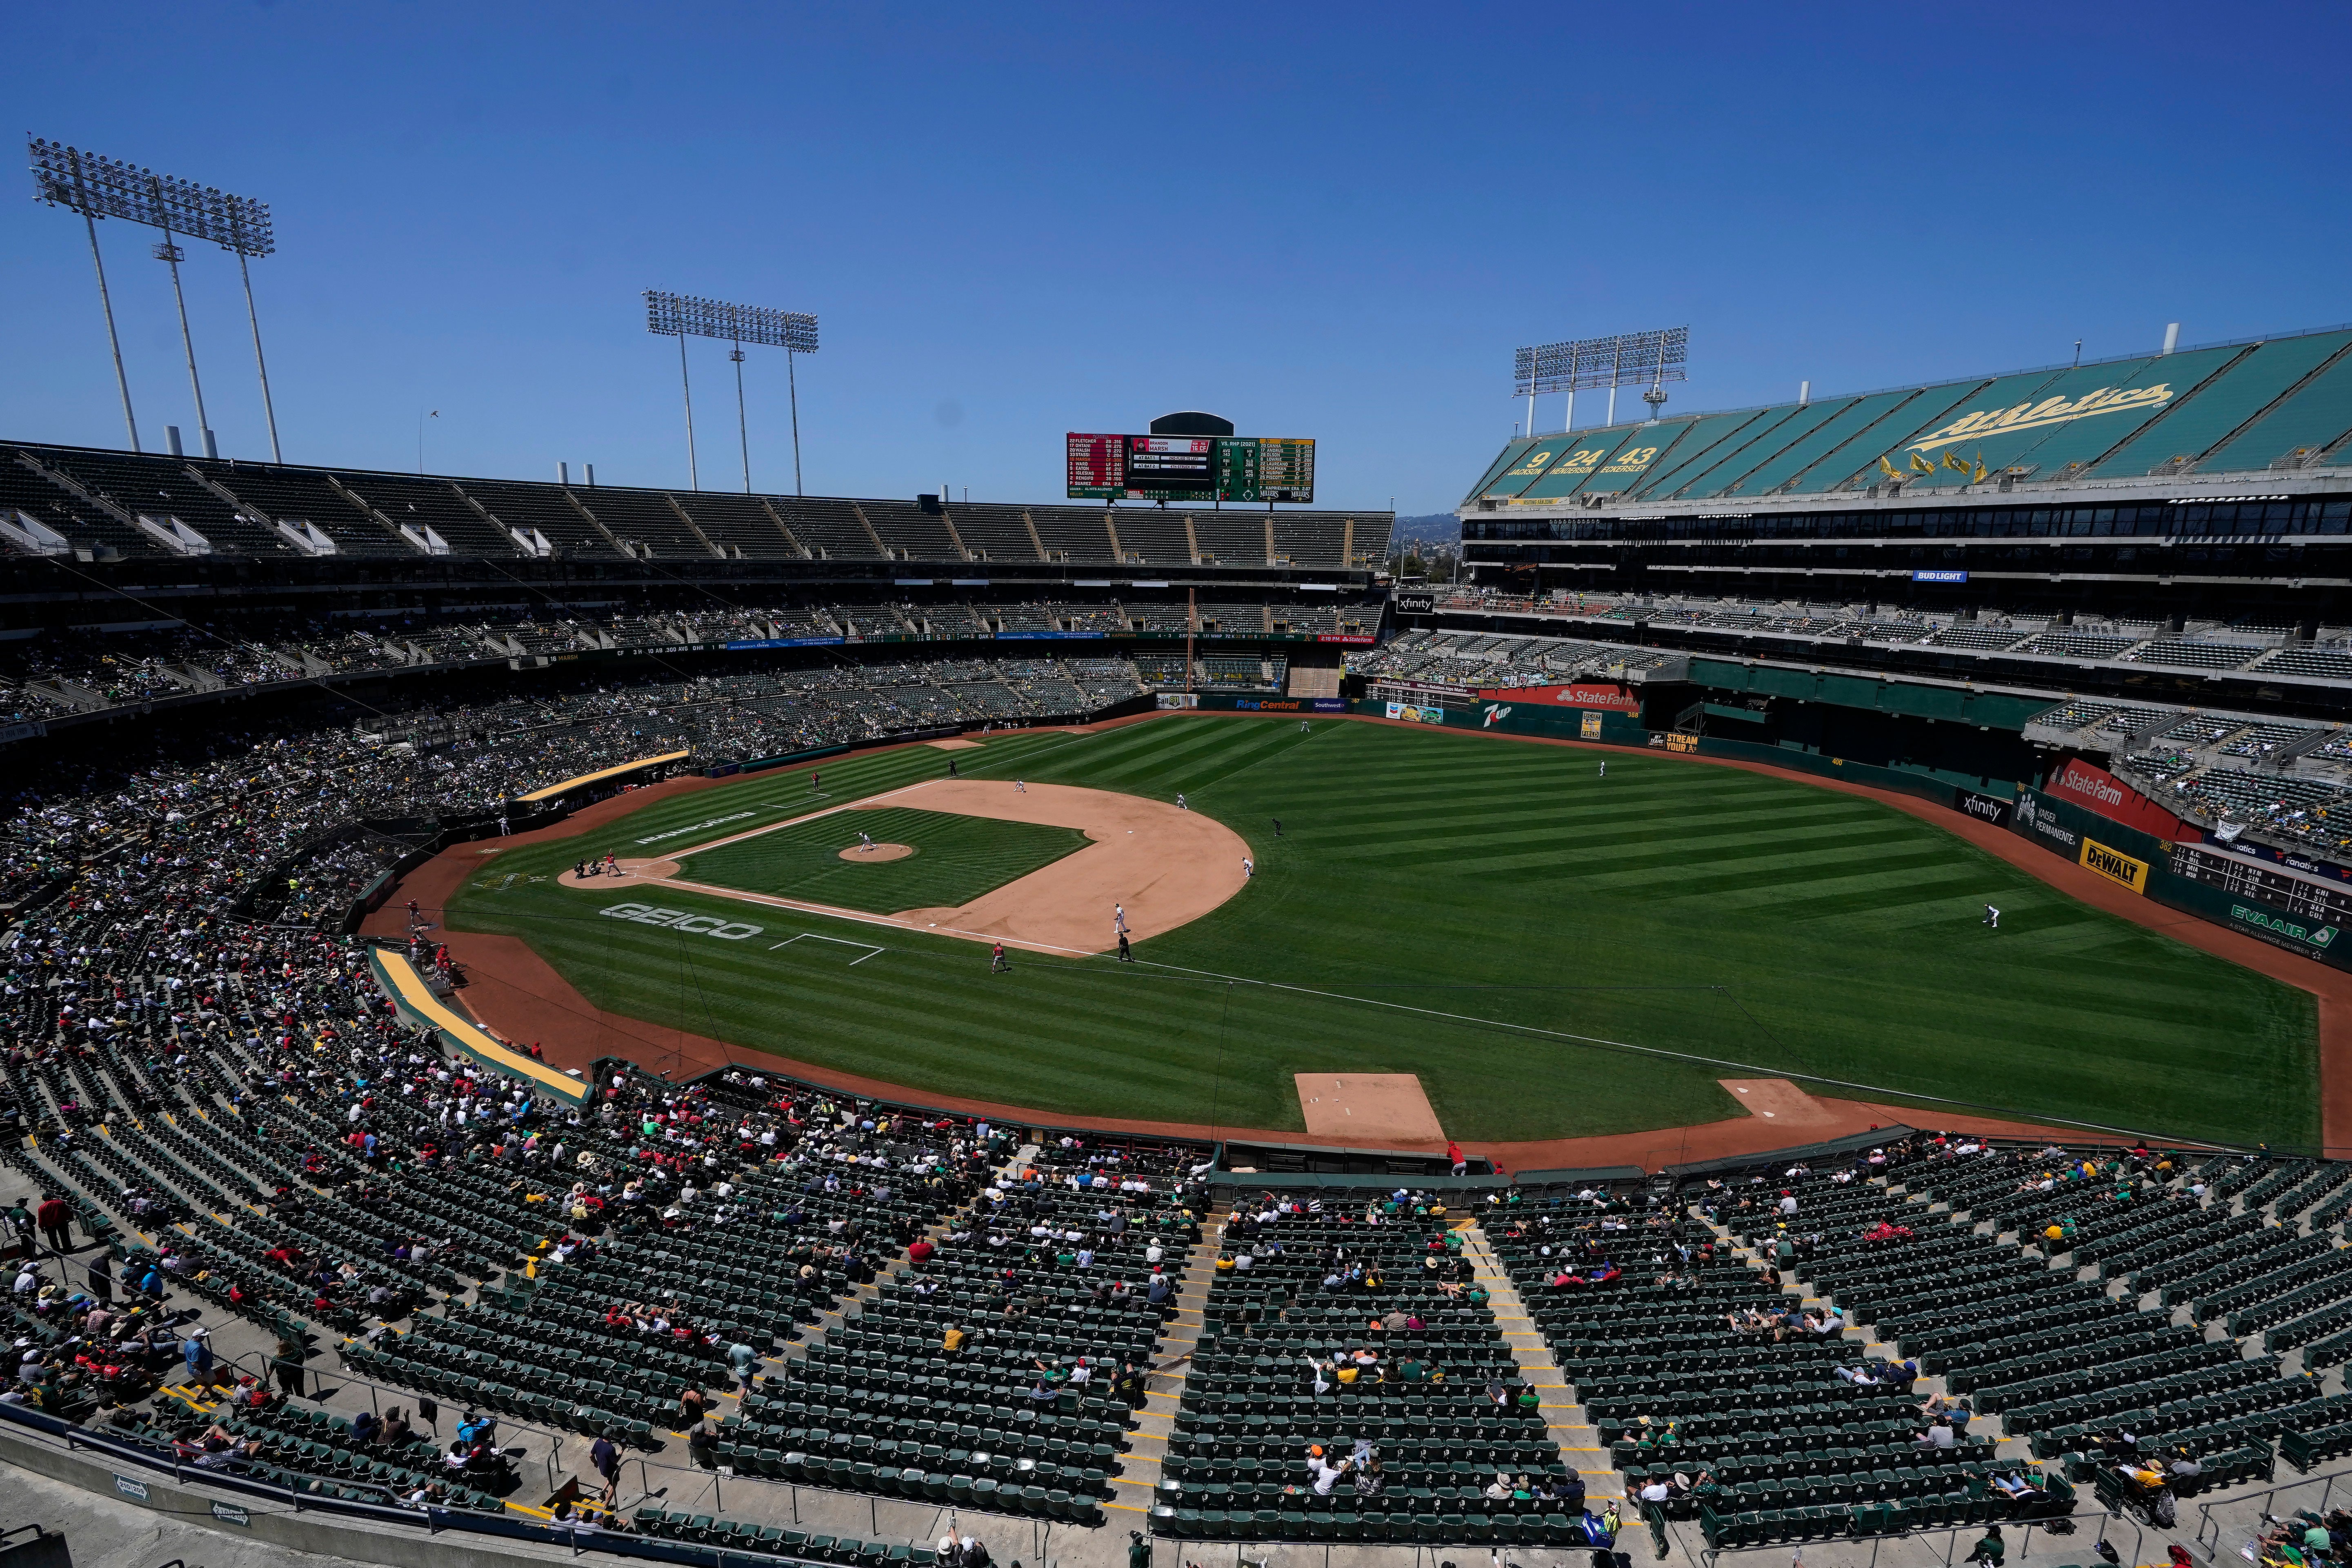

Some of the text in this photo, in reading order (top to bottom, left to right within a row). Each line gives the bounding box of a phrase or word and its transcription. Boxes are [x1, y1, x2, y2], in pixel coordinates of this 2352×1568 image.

[1905, 383, 2174, 452] Athletics
[1526, 452, 1551, 468] 9
[1563, 449, 1605, 467] 24
[1616, 447, 1657, 465] 43
[1600, 465, 1650, 473] ECKERSLEY
[1291, 491, 1309, 499] MILLERS
[1400, 598, 1432, 610] xfinity
[1575, 691, 1636, 706] StateFarm
[1236, 700, 1299, 710] RingCentral
[1483, 703, 1512, 728] 7 UP
[1667, 734, 1698, 745] STREAM
[1667, 742, 1685, 752] YOUR
[2065, 770, 2122, 806] StateFarm
[1964, 795, 2001, 821] xfinity
[2038, 807, 2056, 823] KAISER
[2036, 820, 2074, 845] PERMANENTE
[2160, 840, 2172, 852] 362
[2187, 864, 2199, 872] MIA
[2248, 867, 2262, 877] NYM
[2185, 870, 2197, 879] WSH
[2248, 874, 2259, 883] CIN
[2315, 887, 2329, 897] CHI
[2310, 903, 2324, 913] SEA
[599, 903, 764, 940] GEICO
[2234, 925, 2249, 933] STAR
[2250, 930, 2280, 945] ALLIANCE
[2281, 941, 2309, 955] MEMBER
[133, 1484, 144, 1494] 209
